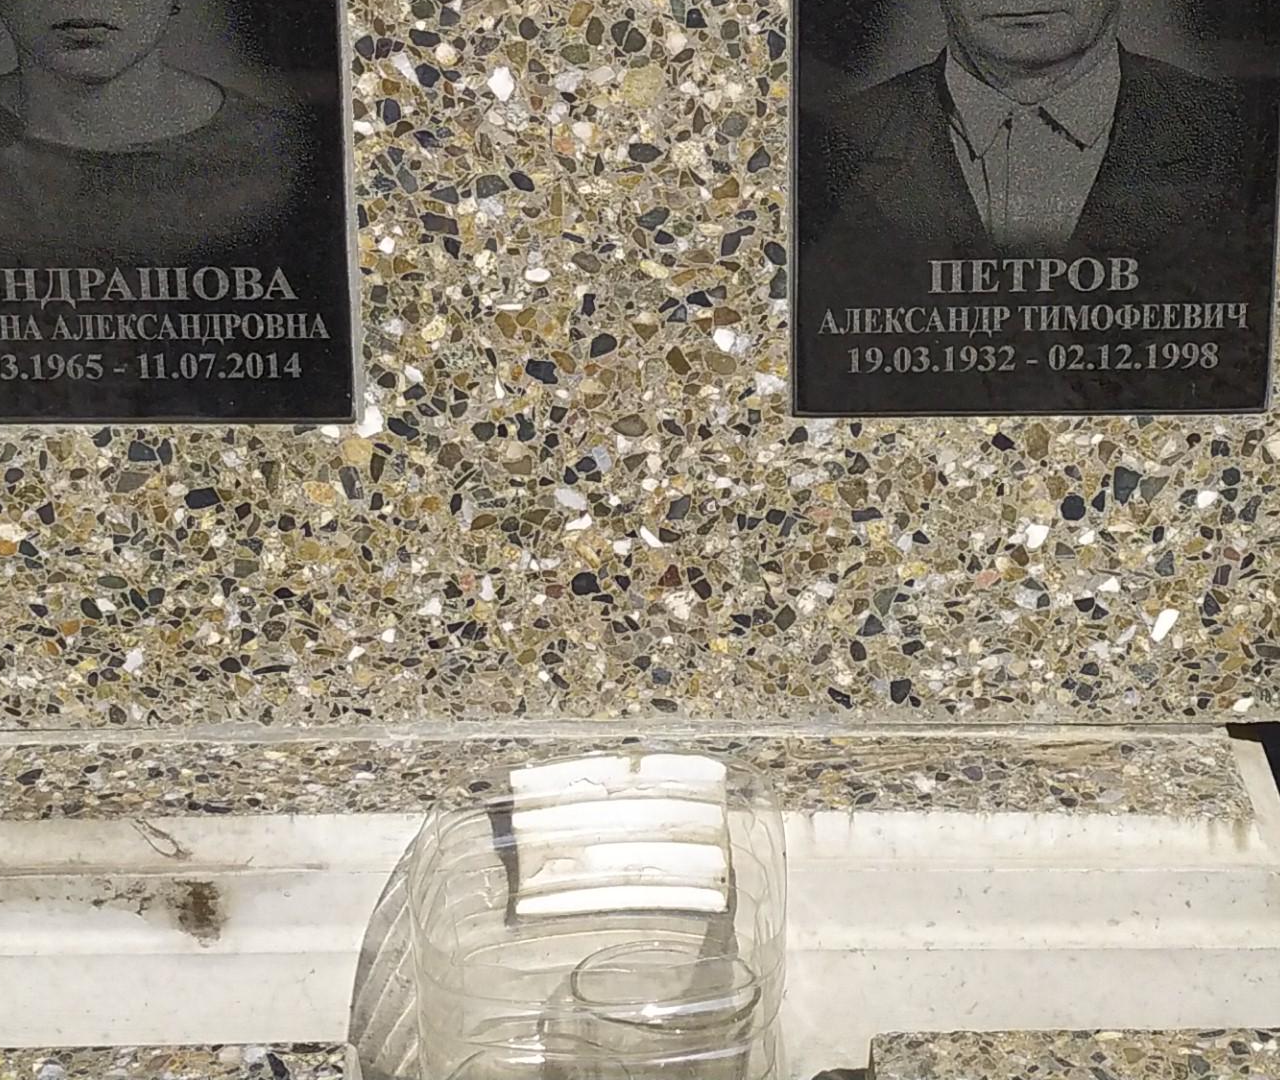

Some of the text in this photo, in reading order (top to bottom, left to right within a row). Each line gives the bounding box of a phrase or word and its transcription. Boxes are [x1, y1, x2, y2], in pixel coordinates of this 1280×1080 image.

[927, 257, 1140, 294] ПЕТРОВ
[51, 312, 331, 346] АЛЕКСАНДРОВНА
[818, 302, 1249, 338] АЛЕКСАНДР ТИМОФЕЕВИЧ
[138, 351, 302, 380] 11.07.2014
[847, 346, 1017, 374] 19.03.1932
[1048, 343, 1220, 372] 02.12.1998
